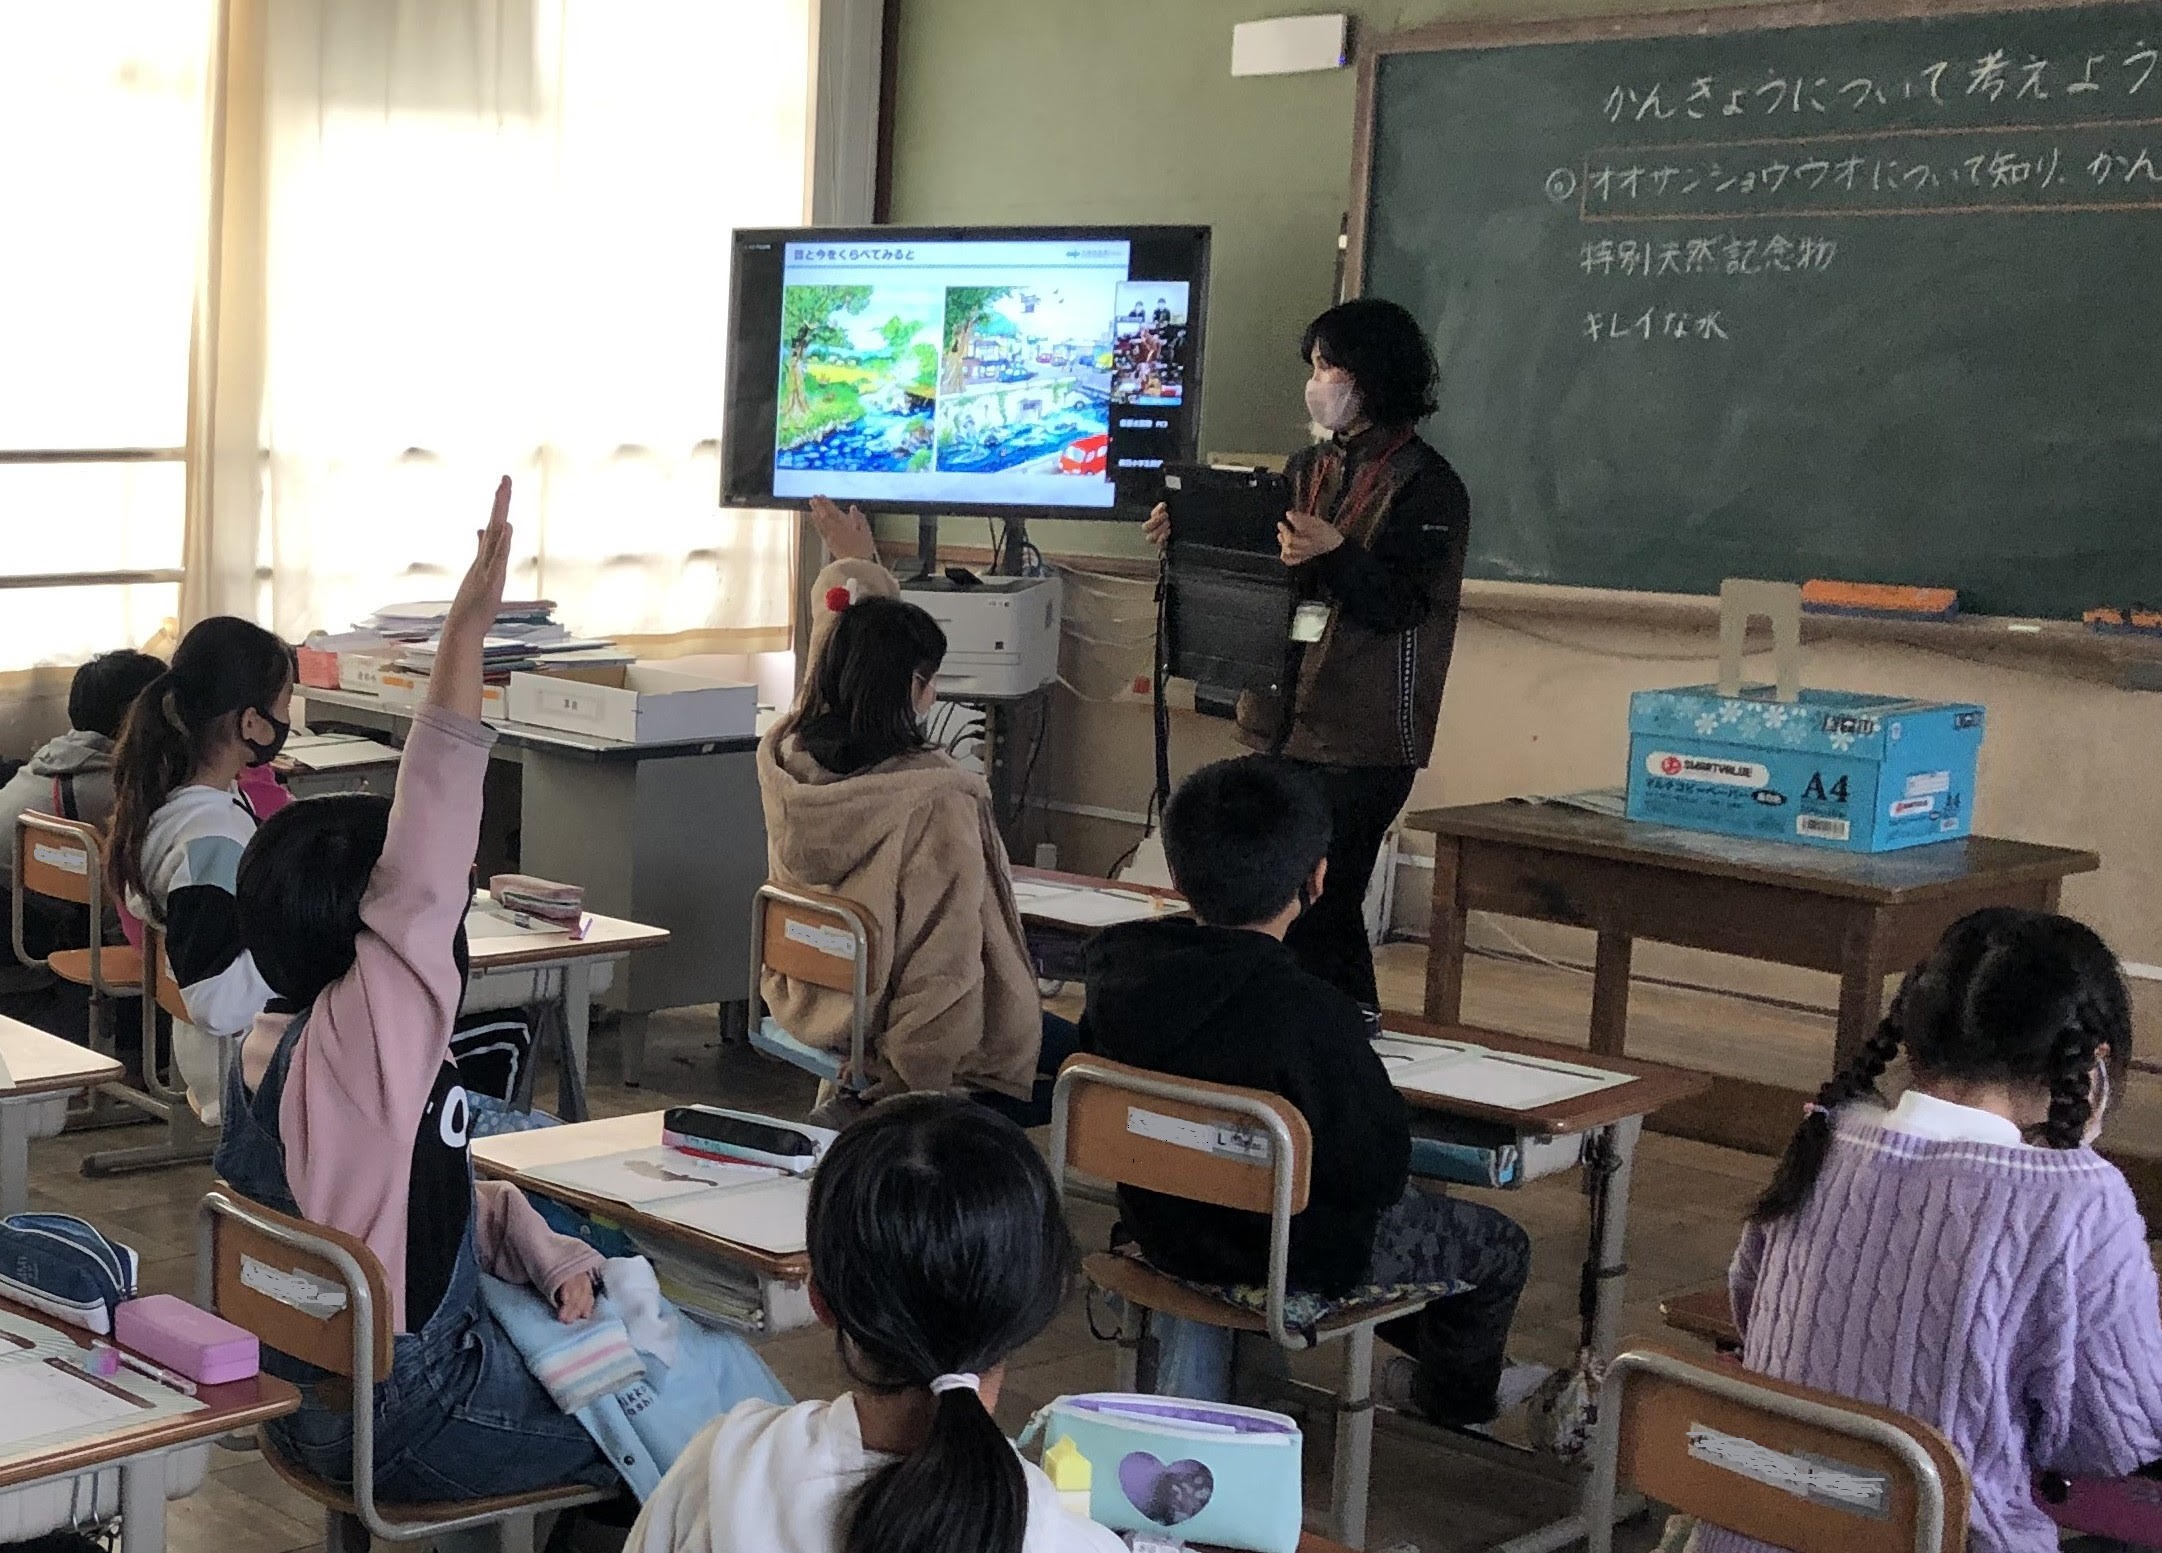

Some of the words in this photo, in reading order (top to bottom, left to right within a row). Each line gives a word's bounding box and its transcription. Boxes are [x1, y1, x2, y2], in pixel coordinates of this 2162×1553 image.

[1603, 40, 2159, 123] かんきょうについて考えよう
[1580, 234, 1838, 277] 特別天然記念物
[1584, 307, 1729, 342] キレイな水
[1801, 770, 1850, 803] A4
